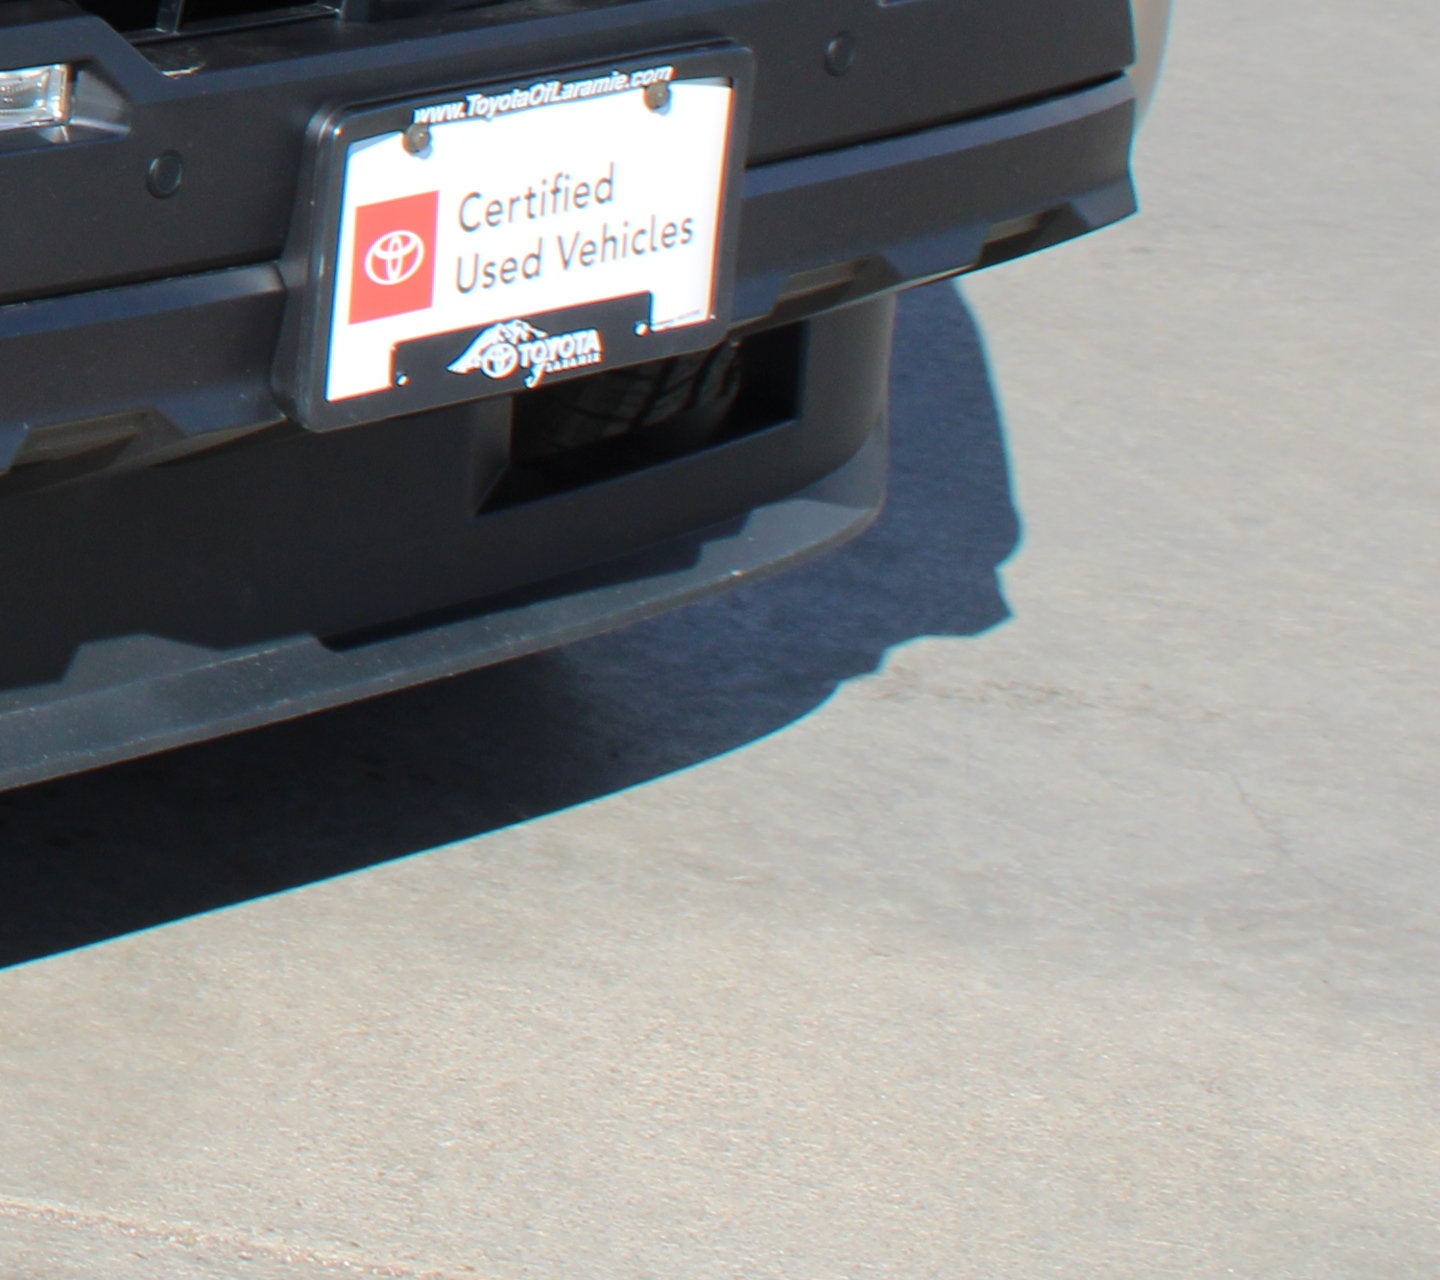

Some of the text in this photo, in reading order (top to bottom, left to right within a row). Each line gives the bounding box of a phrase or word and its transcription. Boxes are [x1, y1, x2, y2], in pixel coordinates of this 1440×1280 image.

[412, 66, 676, 123] www.ToyotaOfLaramie.com
[457, 161, 615, 233] Certified
[455, 214, 694, 294] Used Vehicles
[517, 328, 603, 368] TOYOTA
